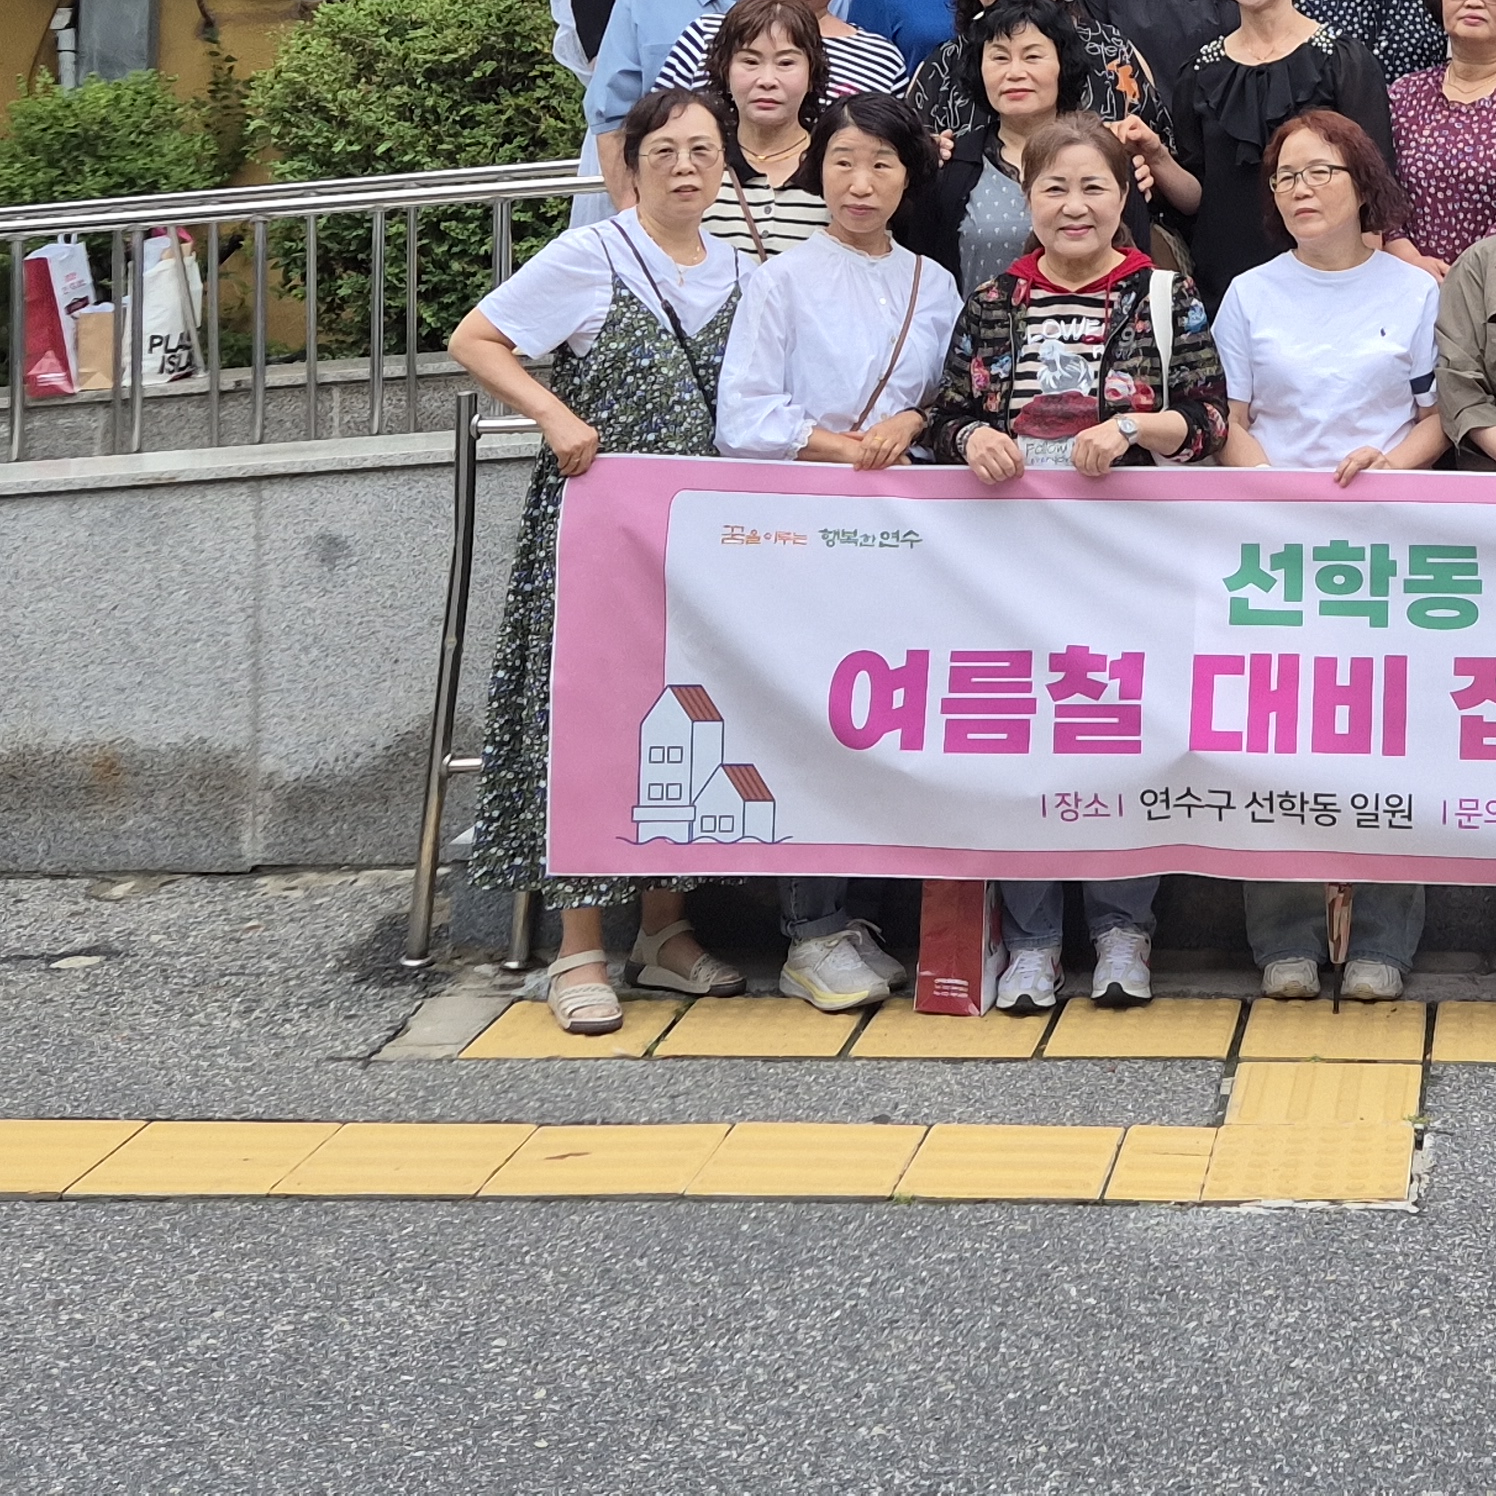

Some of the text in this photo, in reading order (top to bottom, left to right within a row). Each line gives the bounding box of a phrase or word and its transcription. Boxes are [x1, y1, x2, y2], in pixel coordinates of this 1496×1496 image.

[1223, 539, 1483, 630] 선학동
[828, 644, 1146, 755] 여름철
[1189, 653, 1408, 757] 대비
[1139, 787, 1236, 823] 연수구
[1244, 789, 1342, 826] 선학동
[1349, 792, 1414, 830] 일원
